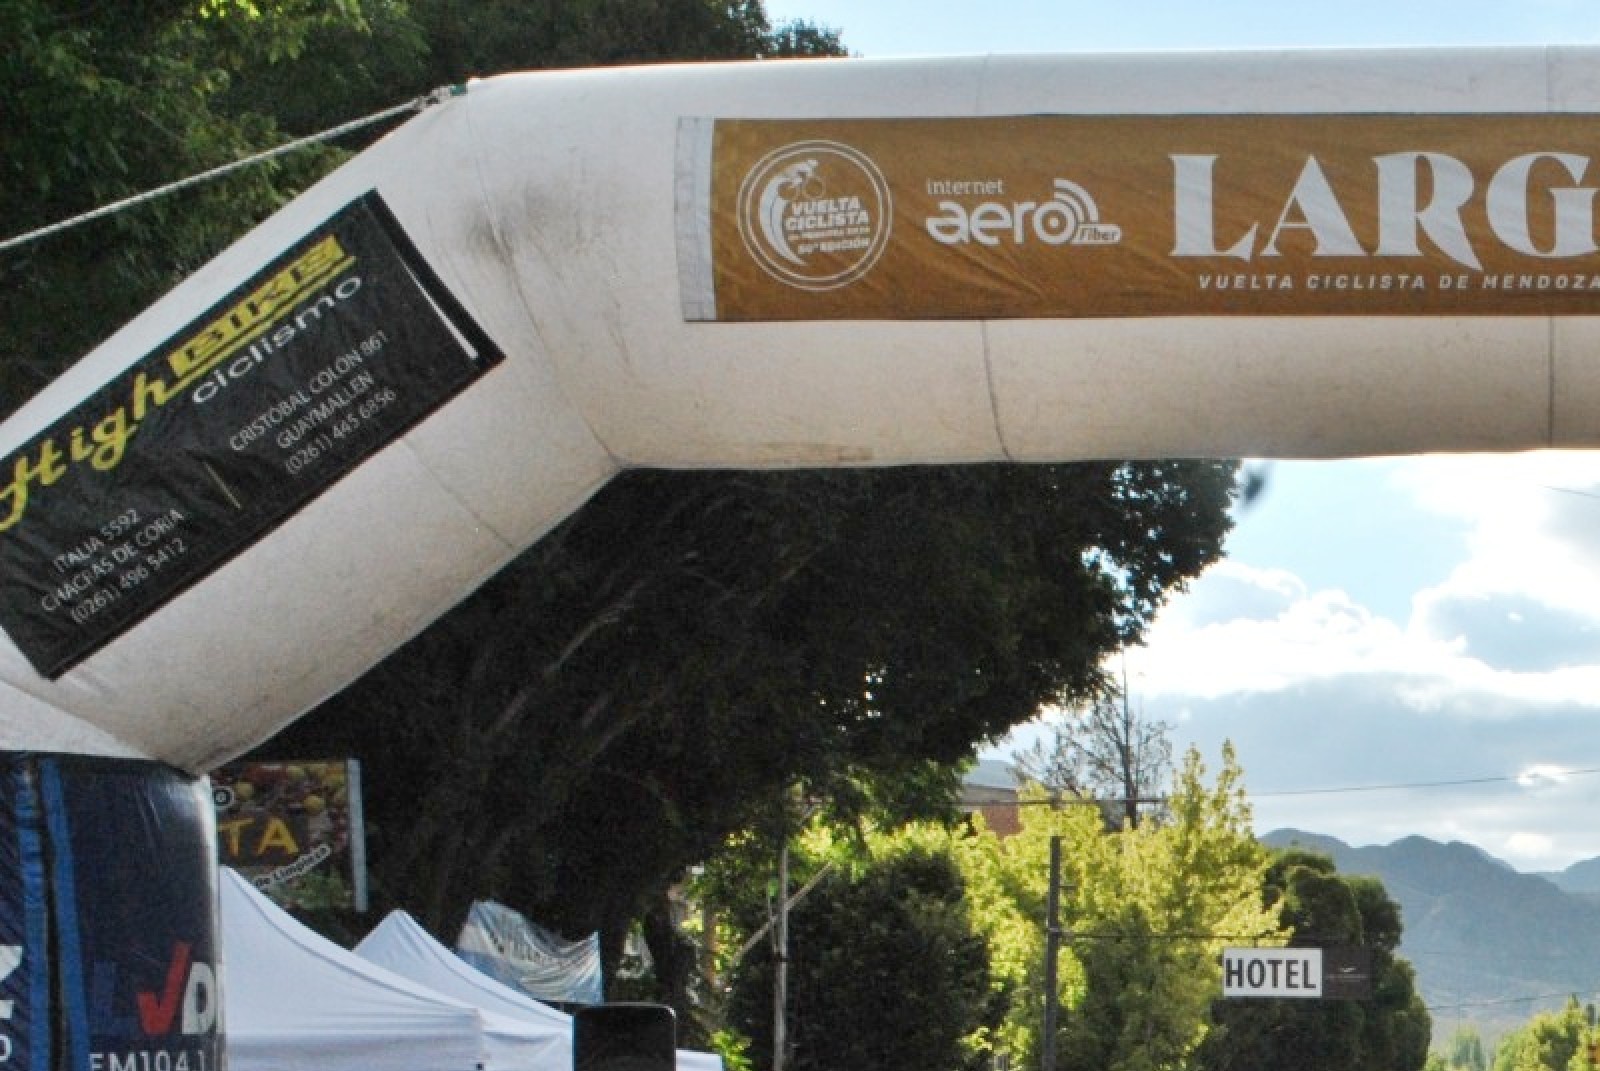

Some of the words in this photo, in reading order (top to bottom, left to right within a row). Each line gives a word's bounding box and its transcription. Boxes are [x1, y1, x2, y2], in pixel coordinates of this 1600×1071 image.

[927, 179, 1004, 195] internet
[786, 210, 870, 231] CICLISTA
[792, 196, 860, 215] VUELTA
[927, 200, 1076, 244] aero
[1200, 274, 1294, 290] VUELTA
[1307, 274, 1426, 290] CICLISTA
[1439, 274, 1469, 290] DE
[192, 276, 362, 405] ciclismo
[274, 371, 376, 450] GUAYMALLEN
[39, 556, 114, 615] CHACRAS
[111, 541, 137, 564] DE
[134, 507, 184, 548] CORIA
[147, 538, 186, 571] 5412
[1225, 957, 1317, 989] HOTEL
